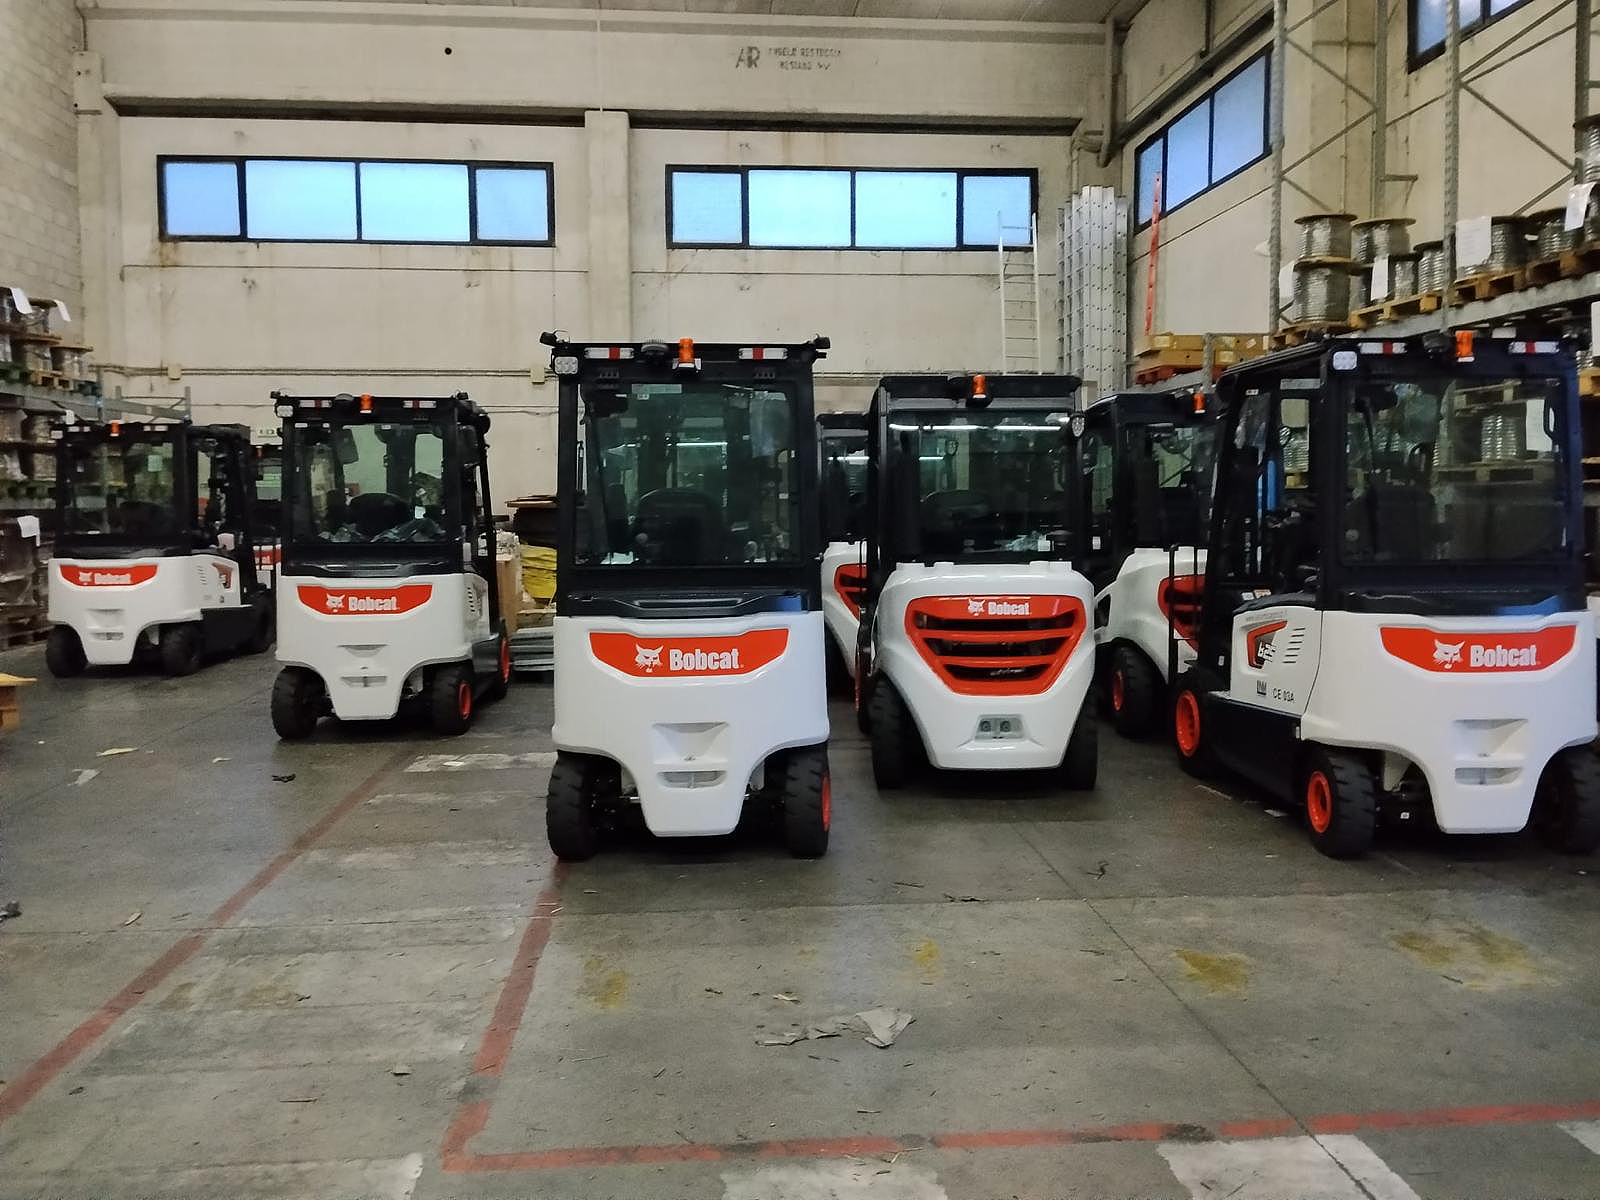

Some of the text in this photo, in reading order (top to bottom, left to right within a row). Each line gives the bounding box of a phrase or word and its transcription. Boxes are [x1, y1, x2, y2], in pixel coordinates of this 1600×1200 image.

[93, 572, 131, 585] Bobcat
[348, 596, 397, 611] Bobcat
[988, 601, 1029, 615] Bobcat
[669, 647, 739, 671] Bobcat
[1469, 644, 1537, 668] Bobcat
